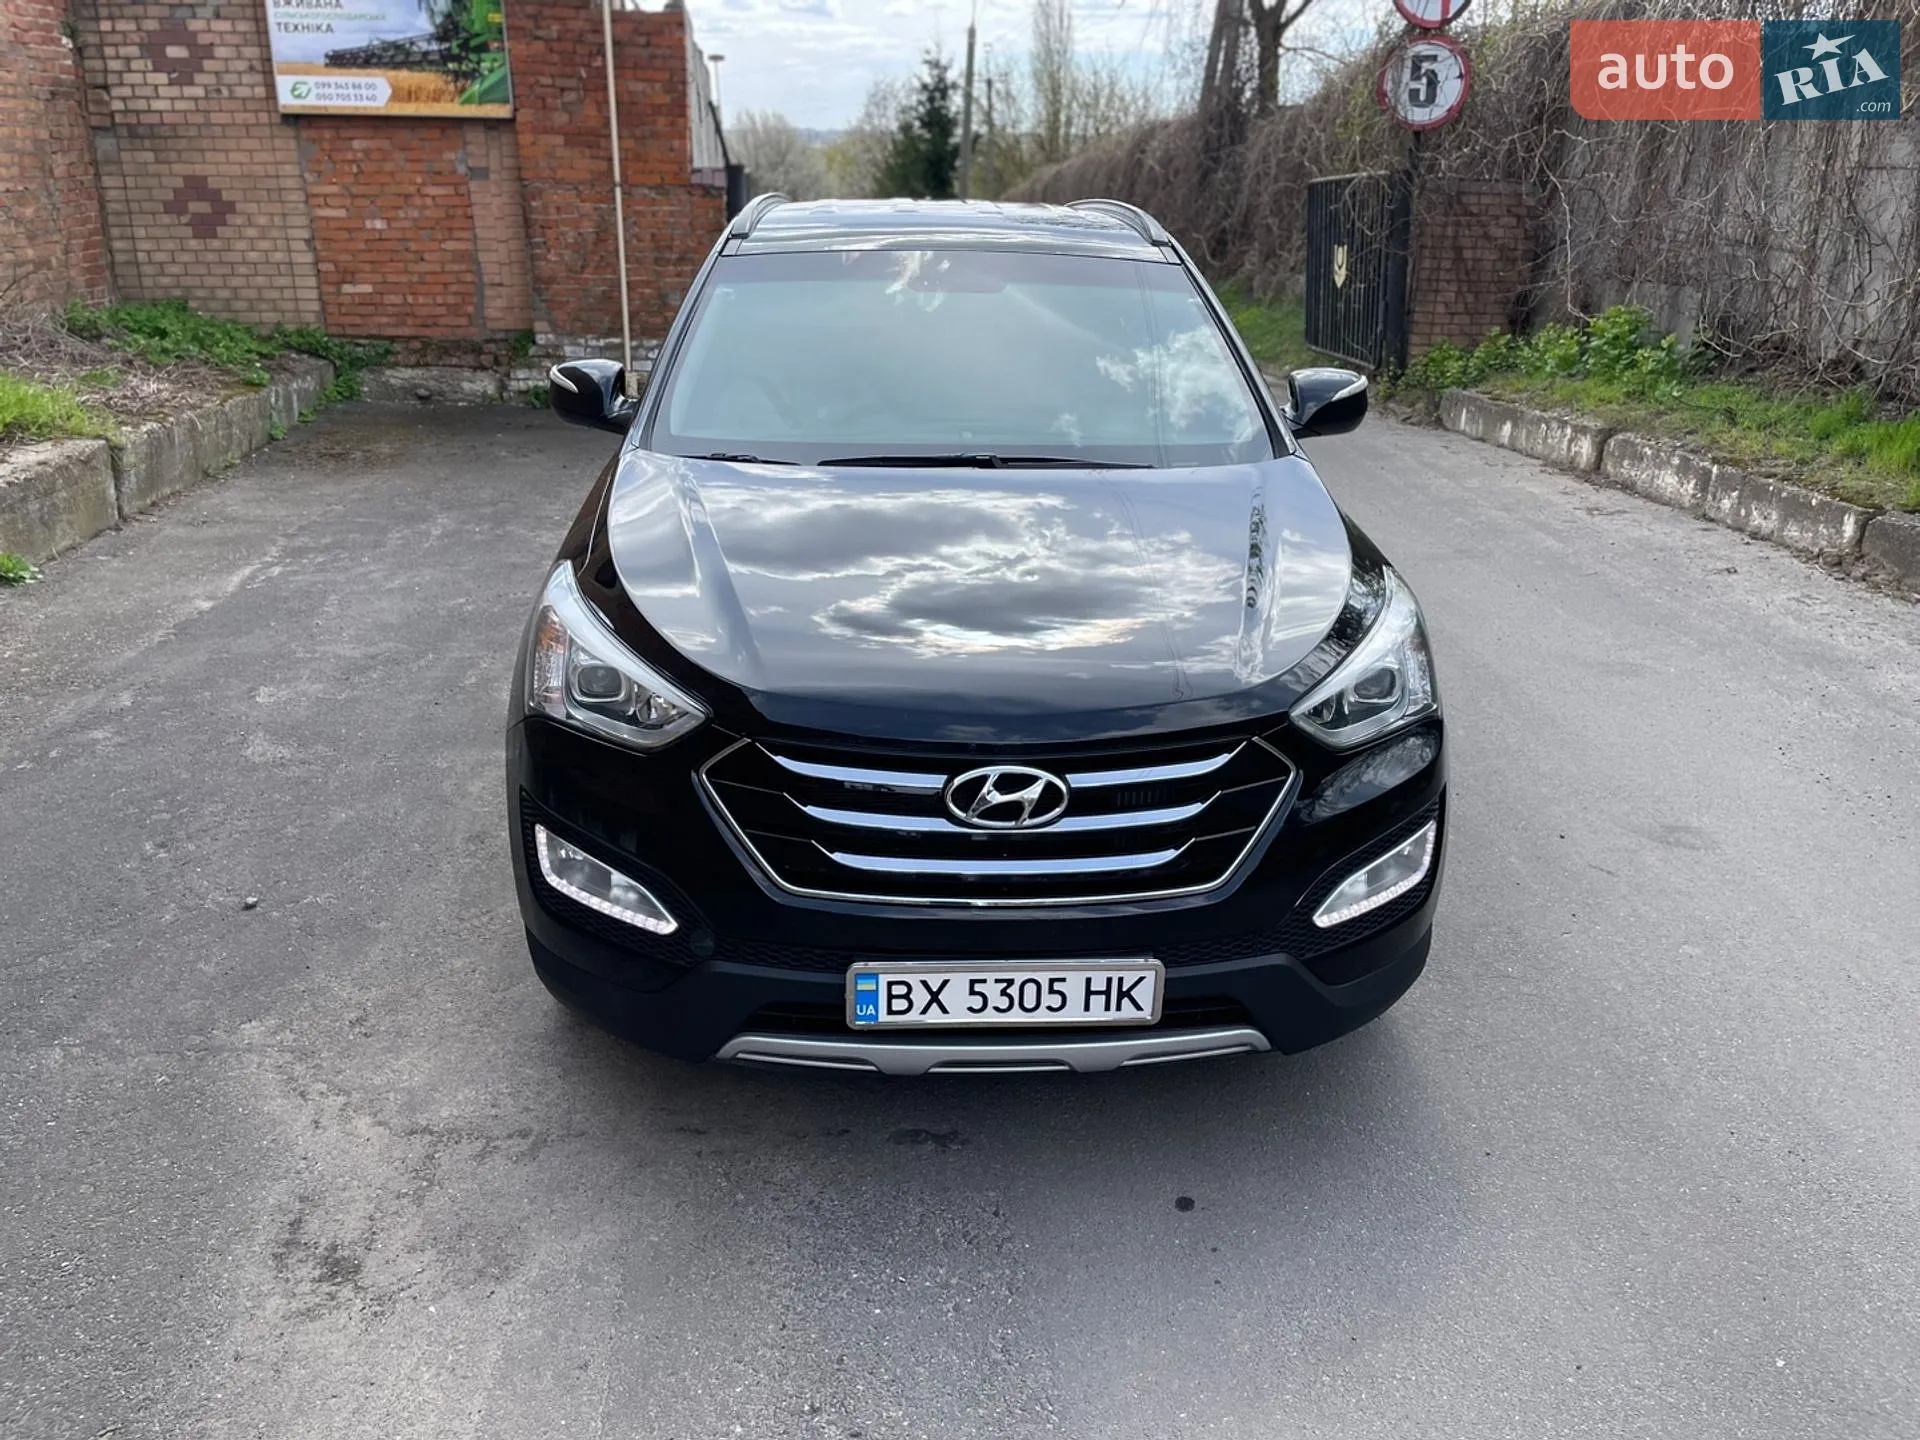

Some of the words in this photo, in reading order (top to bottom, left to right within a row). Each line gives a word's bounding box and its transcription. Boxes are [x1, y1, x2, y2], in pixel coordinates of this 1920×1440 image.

[276, 22, 335, 33] ТЕХНІКА
[1409, 54, 1439, 108] 5
[886, 979, 951, 1015] BX
[966, 977, 1068, 1014] 5305
[1083, 975, 1147, 1012] HK
[856, 1003, 876, 1016] UA
